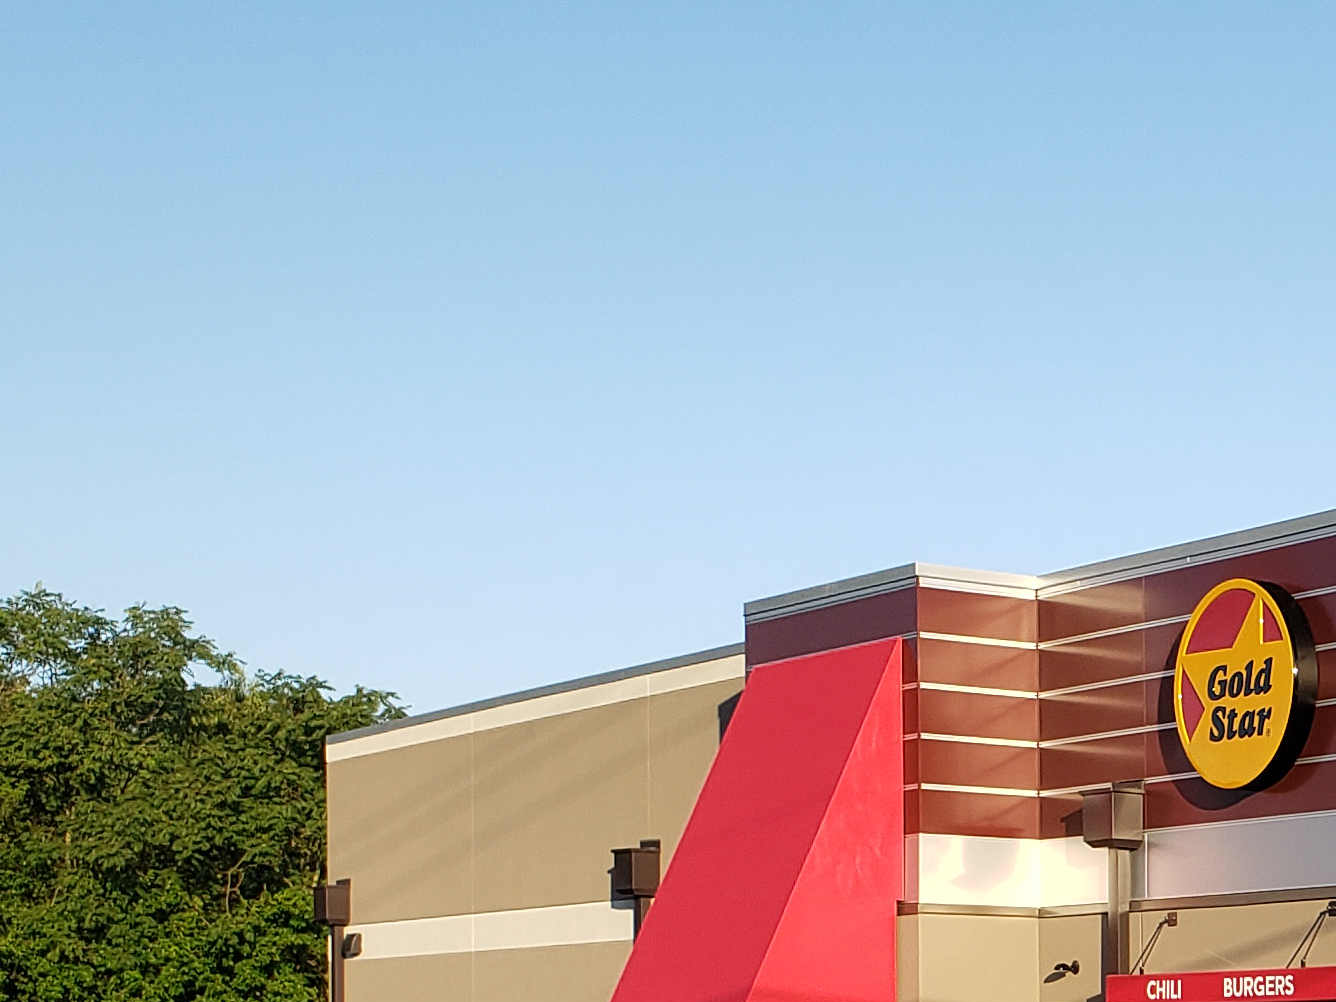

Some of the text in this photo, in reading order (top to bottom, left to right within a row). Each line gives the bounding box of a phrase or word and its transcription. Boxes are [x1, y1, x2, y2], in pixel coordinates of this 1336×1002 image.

[1207, 656, 1273, 701] Gold
[1208, 705, 1271, 742] Star
[1146, 975, 1294, 999] CHILI BURGERS
